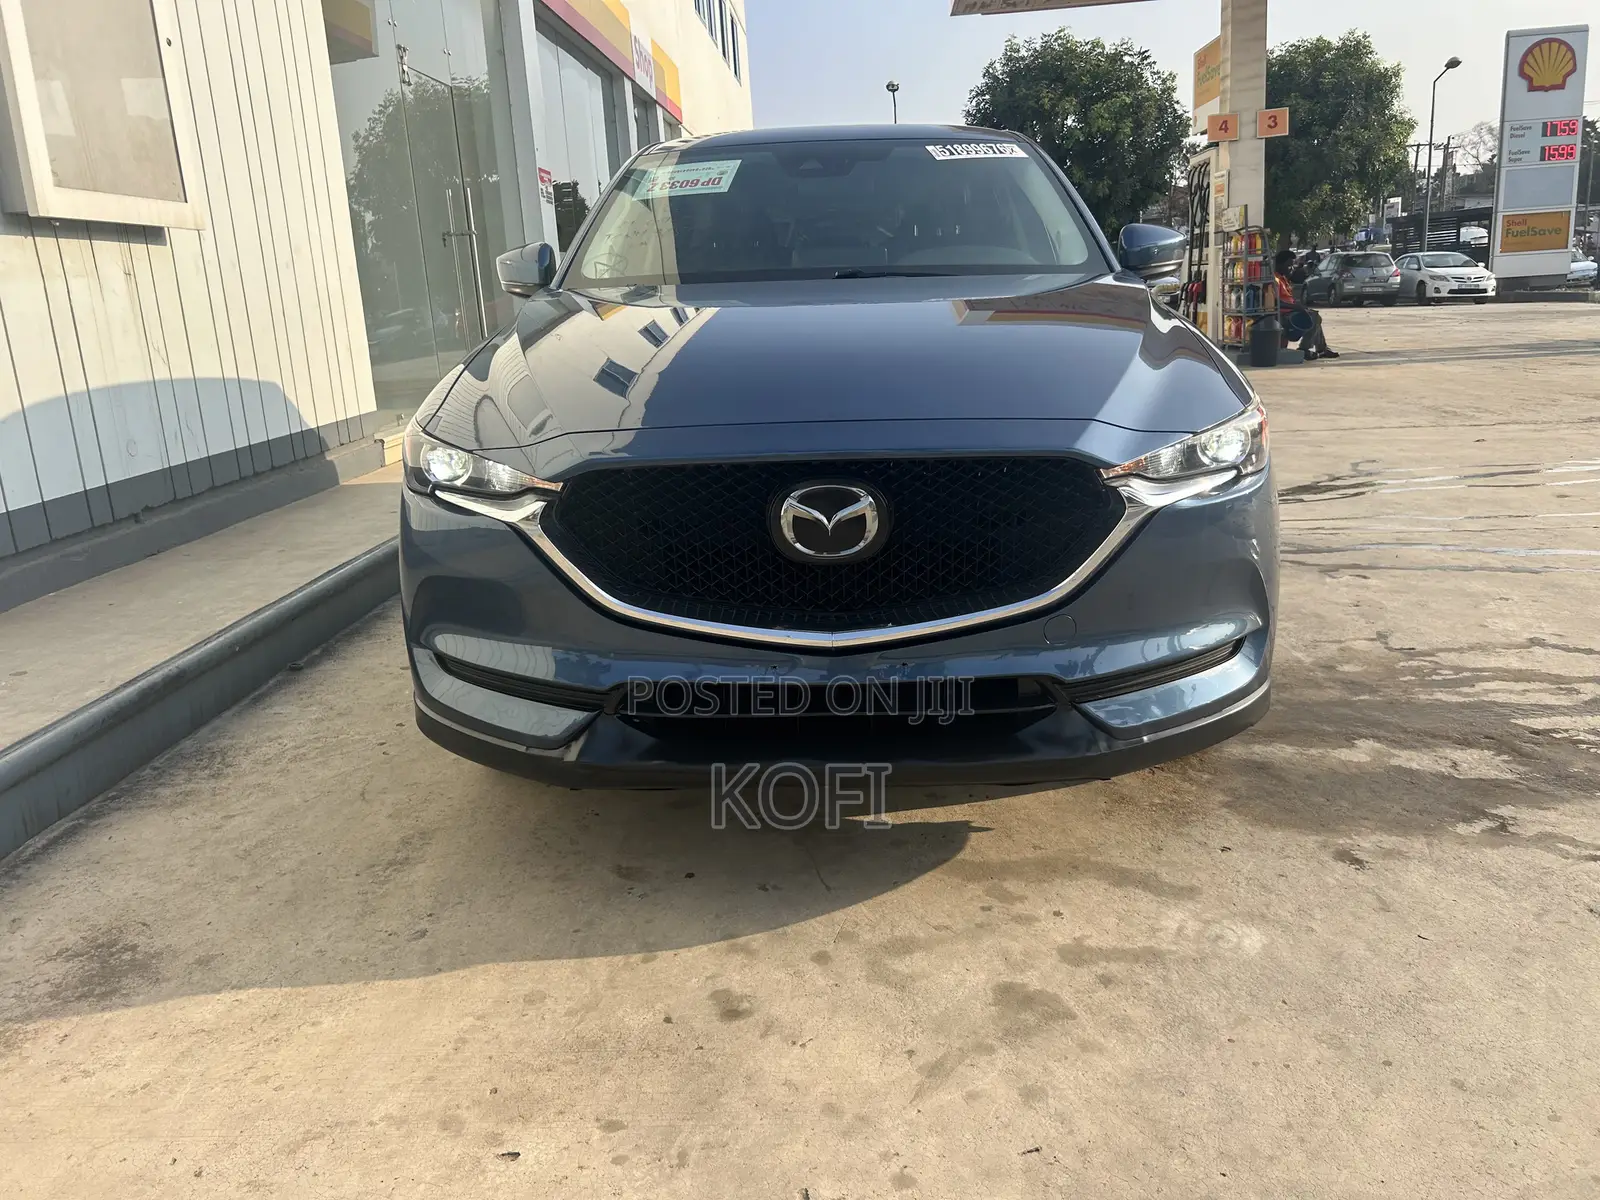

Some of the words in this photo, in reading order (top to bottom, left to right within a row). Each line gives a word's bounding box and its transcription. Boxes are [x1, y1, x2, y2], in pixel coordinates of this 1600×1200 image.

[1218, 119, 1230, 134] 4
[1266, 114, 1279, 130] 3
[700, 176, 724, 188] DP
[1506, 219, 1528, 228] Shell
[1505, 226, 1563, 238] FuelSave
